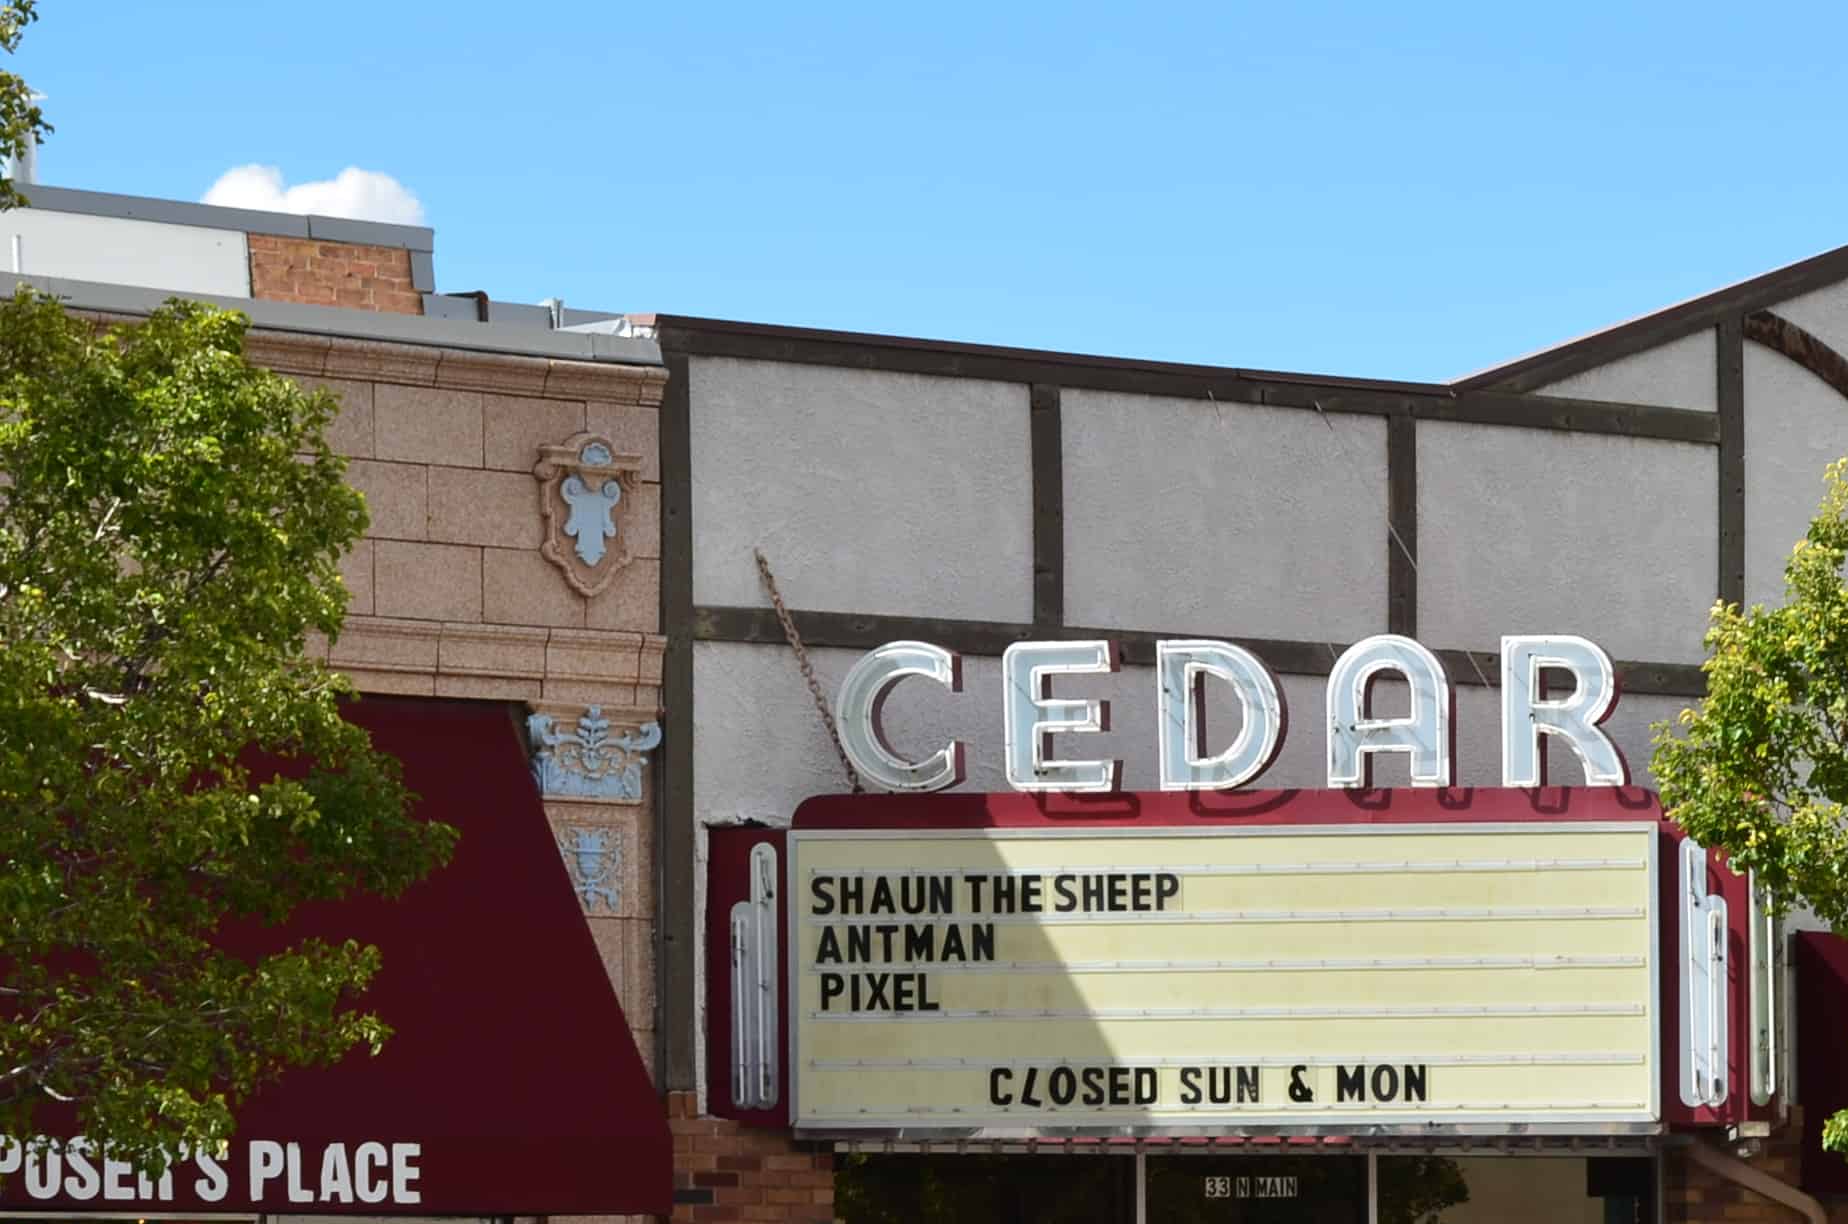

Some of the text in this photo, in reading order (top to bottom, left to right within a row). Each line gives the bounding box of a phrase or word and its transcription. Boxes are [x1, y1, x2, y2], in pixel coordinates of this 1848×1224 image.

[837, 634, 1630, 792] CEDAR
[811, 873, 1180, 915] SHAUN THE SHEEP
[815, 923, 995, 963] ANTMAN
[820, 973, 939, 1011] PIXEL
[990, 1064, 1427, 1107] CLOSED SUN & MON
[249, 1139, 422, 1204] PLACE
[1205, 1176, 1298, 1198] 33 N MAIN
